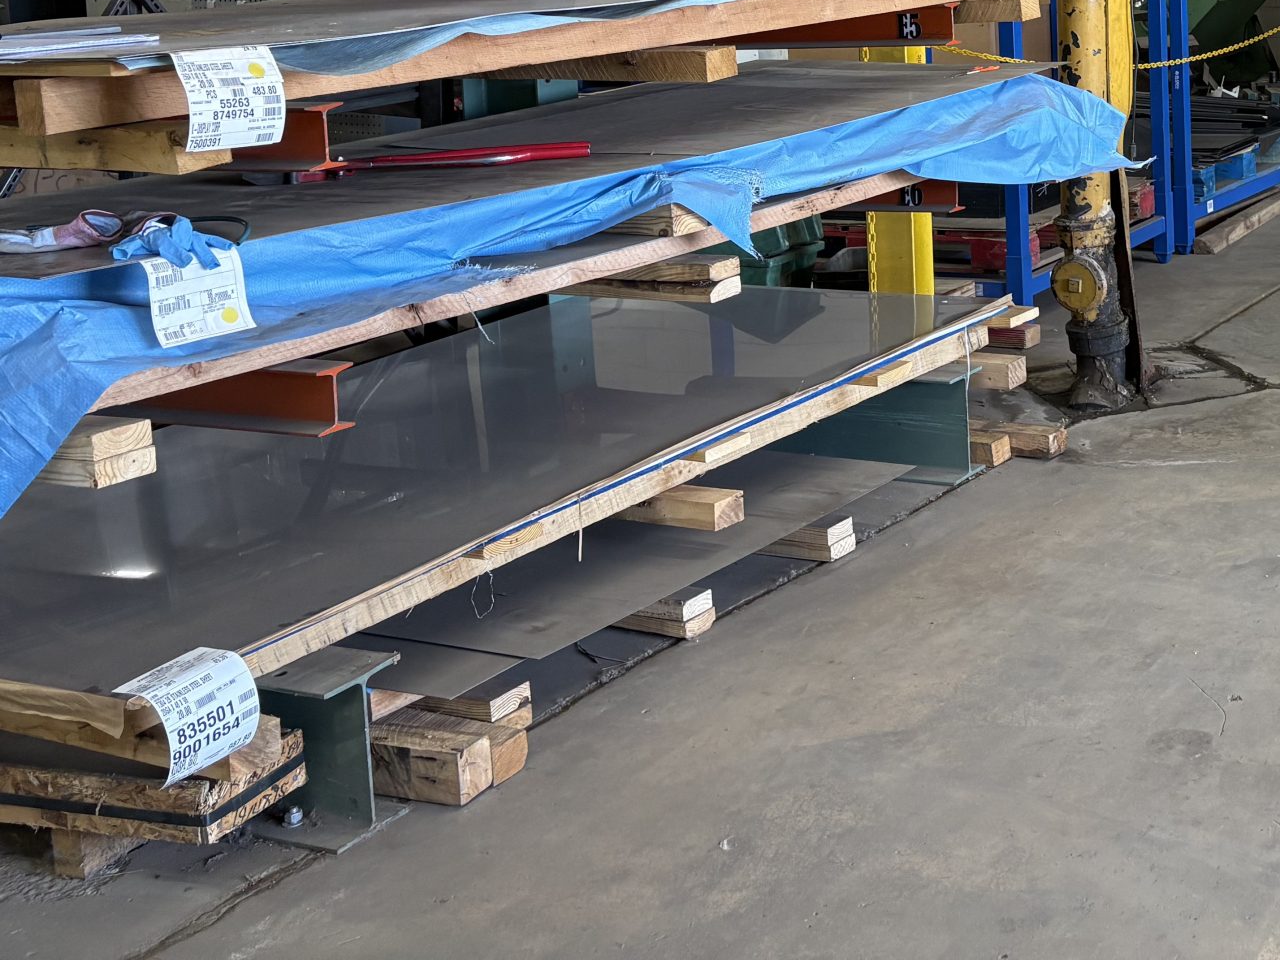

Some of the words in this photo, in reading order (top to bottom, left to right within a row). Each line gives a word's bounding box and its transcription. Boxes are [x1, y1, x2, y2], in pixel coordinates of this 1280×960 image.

[896, 13, 922, 39] E5
[206, 90, 218, 99] PCS
[252, 86, 277, 95] 483.80
[220, 98, 250, 108] 55263
[213, 108, 254, 120] 8749754
[189, 138, 221, 149] 7500391
[172, 686, 192, 701] STAINLESS
[190, 680, 202, 691] STEEL
[177, 706, 192, 720] 20.00
[177, 700, 236, 744] 835501
[172, 716, 241, 764] 9001654
